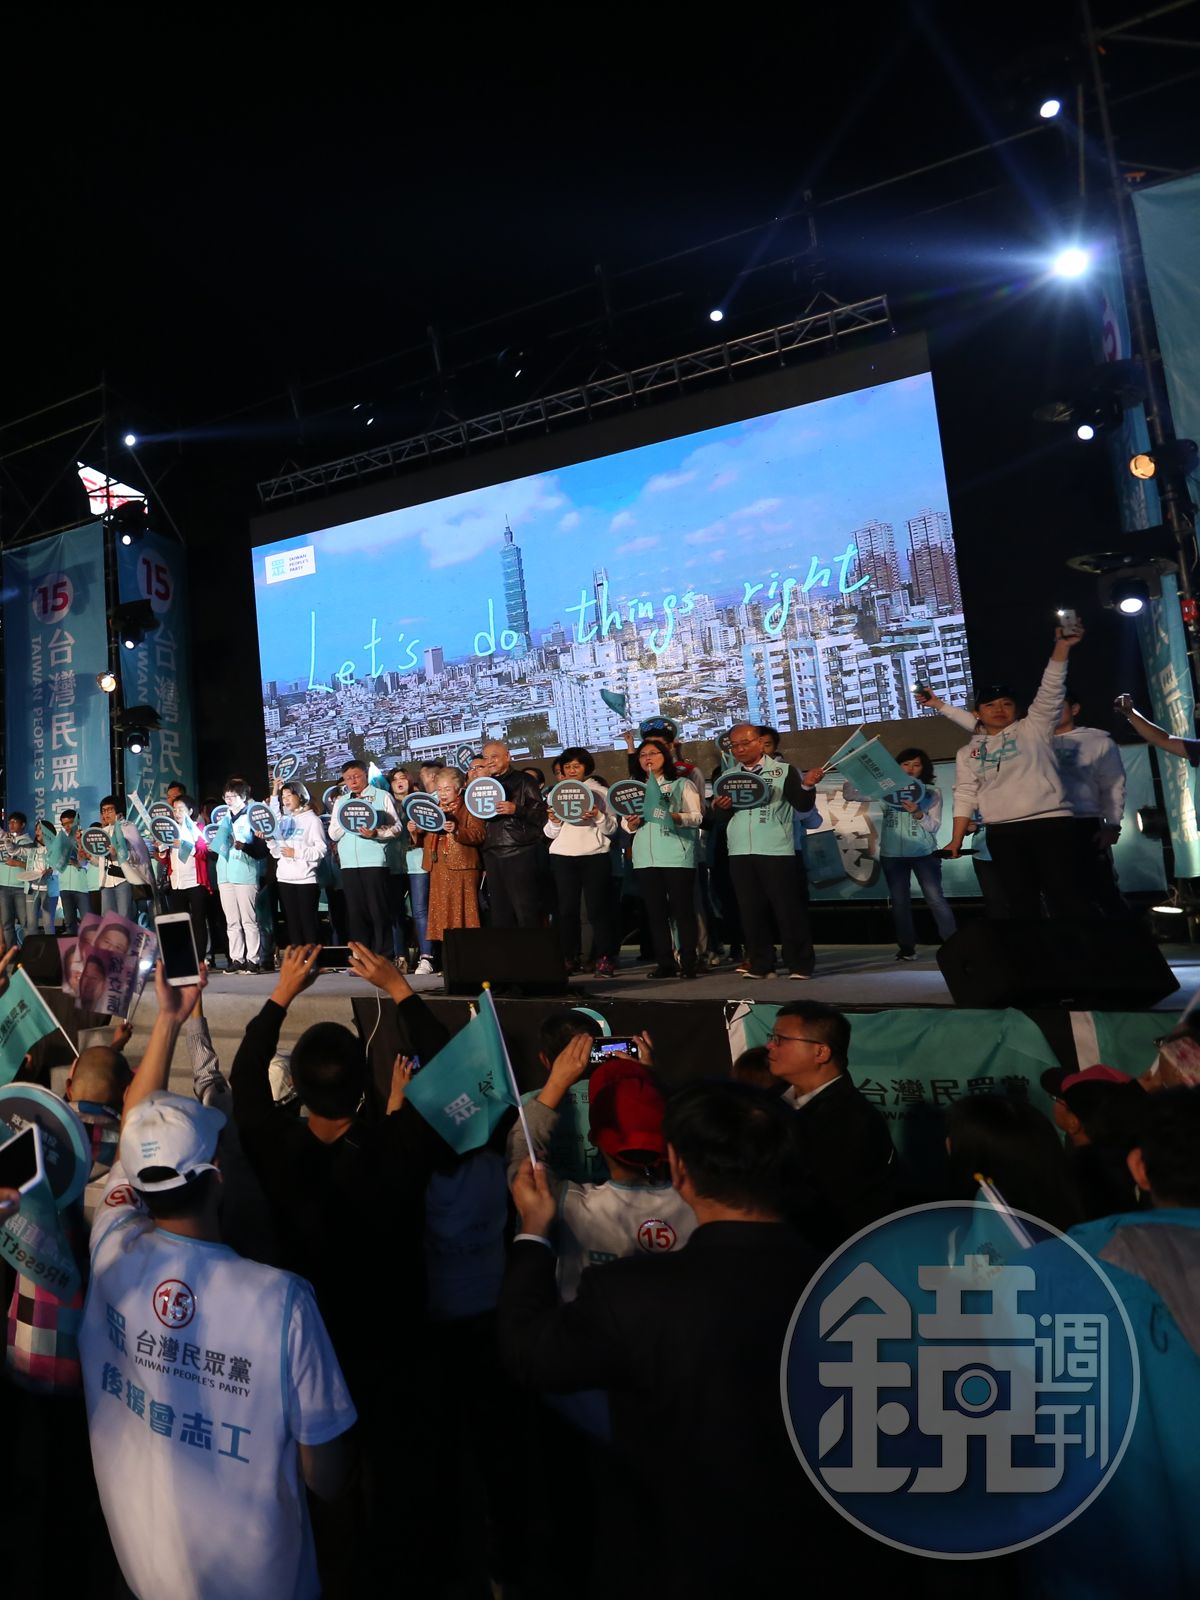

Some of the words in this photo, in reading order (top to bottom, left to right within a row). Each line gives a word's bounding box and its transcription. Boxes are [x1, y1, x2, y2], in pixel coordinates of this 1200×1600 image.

[143, 557, 171, 601] 15
[36, 580, 69, 615] 15
[307, 610, 420, 693] Let's
[474, 598, 519, 657] do
[565, 580, 696, 655] things
[742, 543, 871, 634] right
[31, 634, 42, 699] TAIWAN
[33, 707, 45, 780] PEOPLE'S
[279, 766, 291, 778] 15
[770, 768, 782, 777] 15
[34, 787, 45, 820] PAR
[475, 797, 495, 813] 15
[728, 790, 755, 803] 15
[560, 801, 583, 817] 15
[621, 799, 645, 814] 15
[255, 818, 272, 833] 15
[347, 817, 367, 830] 15
[416, 814, 436, 828] 15
[158, 830, 175, 842] 15
[89, 842, 107, 854] 15
[641, 1227, 671, 1249] 15
[158, 1288, 189, 1322] 15
[134, 1329, 252, 1385] 台灣民眾黨
[134, 1355, 171, 1377] TAIWAN
[172, 1367, 216, 1389] PEOPLE'S
[218, 1380, 251, 1398] PARTY
[101, 1361, 252, 1465] 後援會志工
